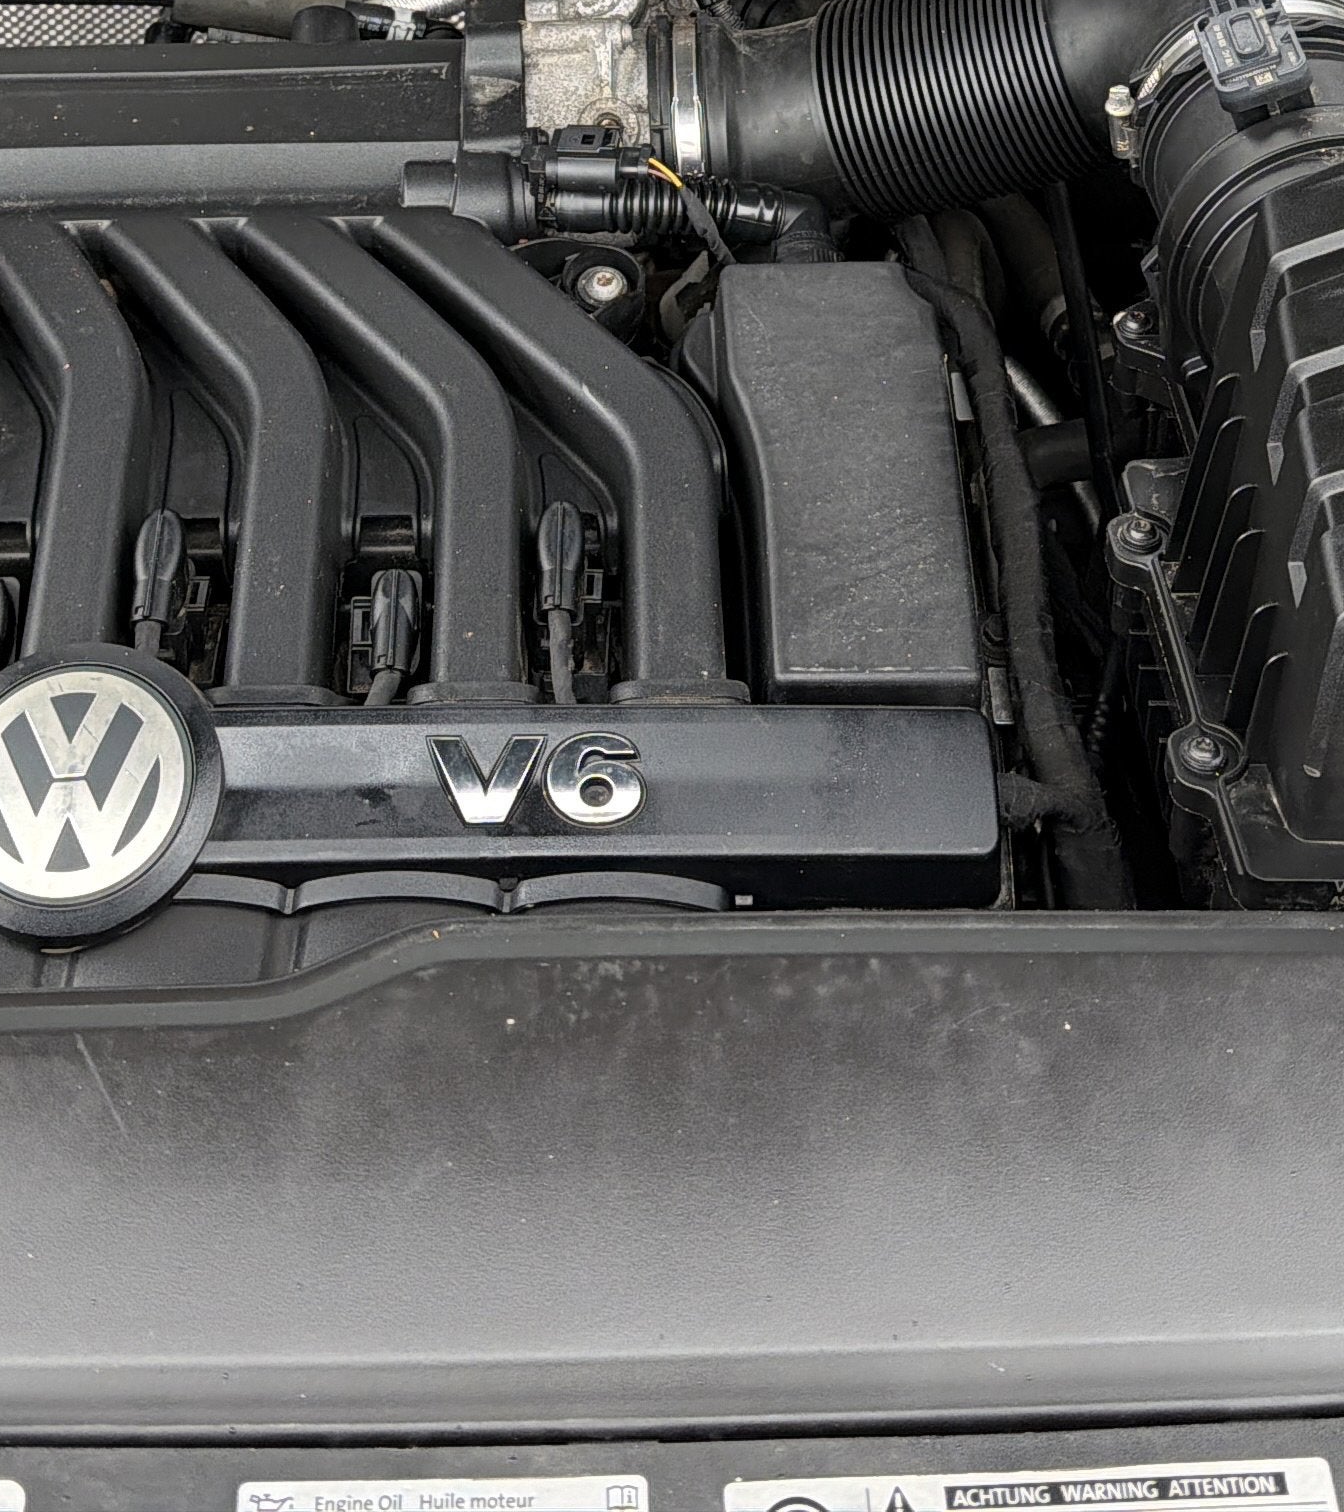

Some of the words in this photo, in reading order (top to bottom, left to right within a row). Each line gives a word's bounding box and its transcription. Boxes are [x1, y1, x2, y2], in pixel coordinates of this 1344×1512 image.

[425, 730, 649, 830] V6
[314, 1494, 373, 1512] Engine
[377, 1493, 403, 1510] Oil
[419, 1493, 466, 1510] Huile
[469, 1493, 535, 1509] moteur
[953, 1484, 1052, 1507] ACHTUNG
[1060, 1479, 1160, 1503] WARNING
